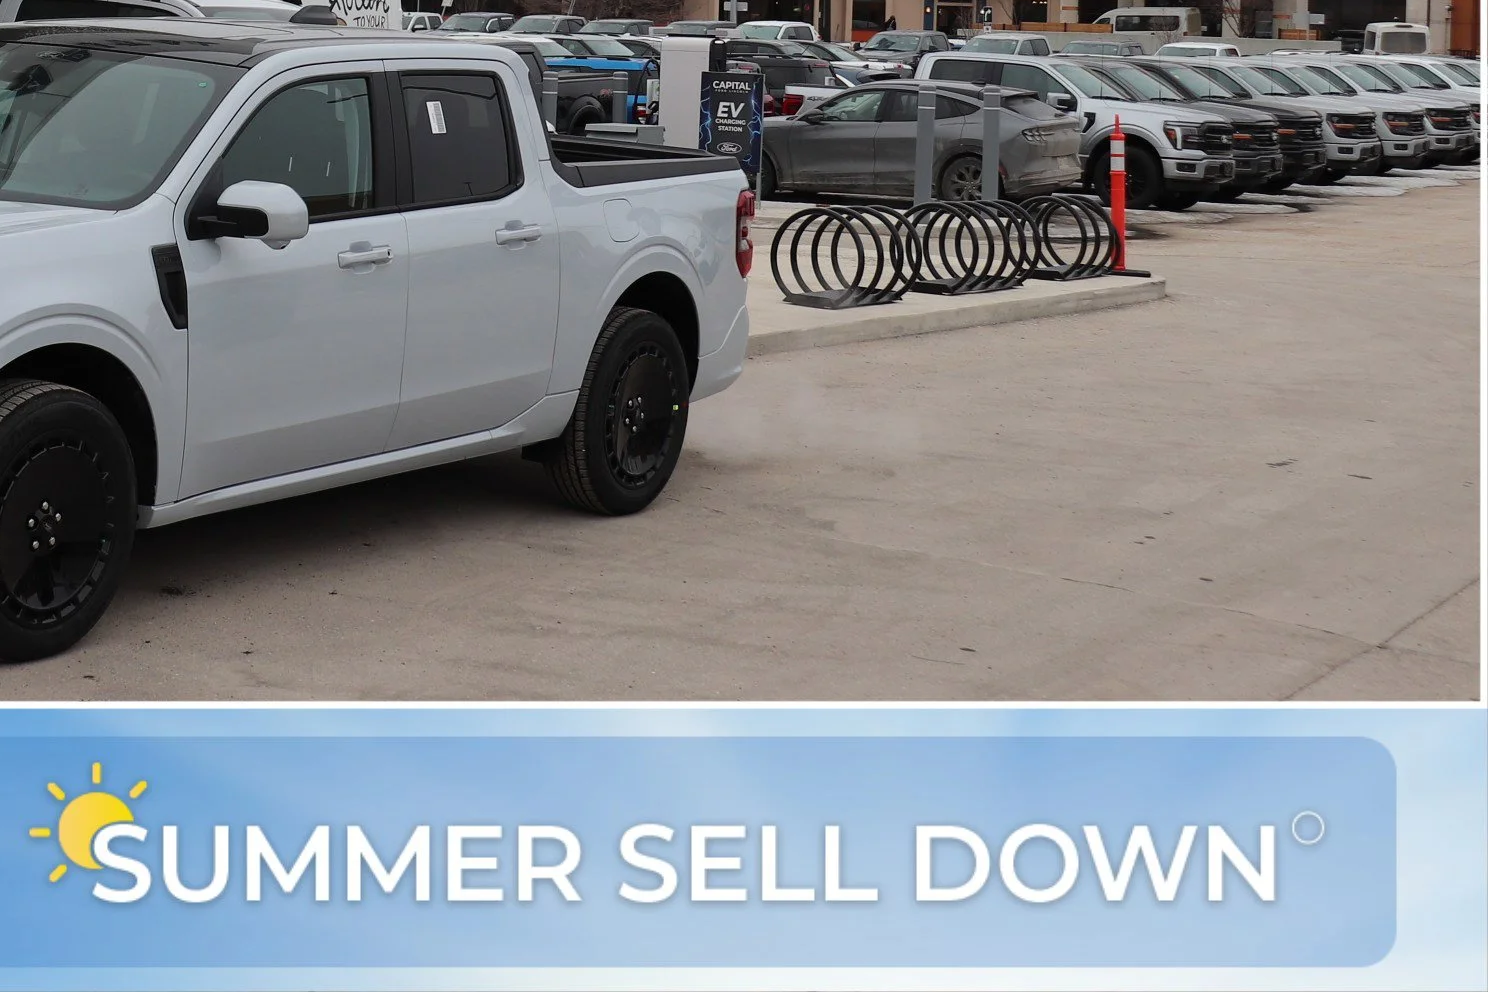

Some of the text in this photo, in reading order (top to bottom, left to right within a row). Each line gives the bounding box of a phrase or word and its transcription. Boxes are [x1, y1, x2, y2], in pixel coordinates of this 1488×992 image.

[366, 15, 386, 28] YOUR
[713, 81, 751, 91] CAPITAL
[717, 101, 745, 118] EV
